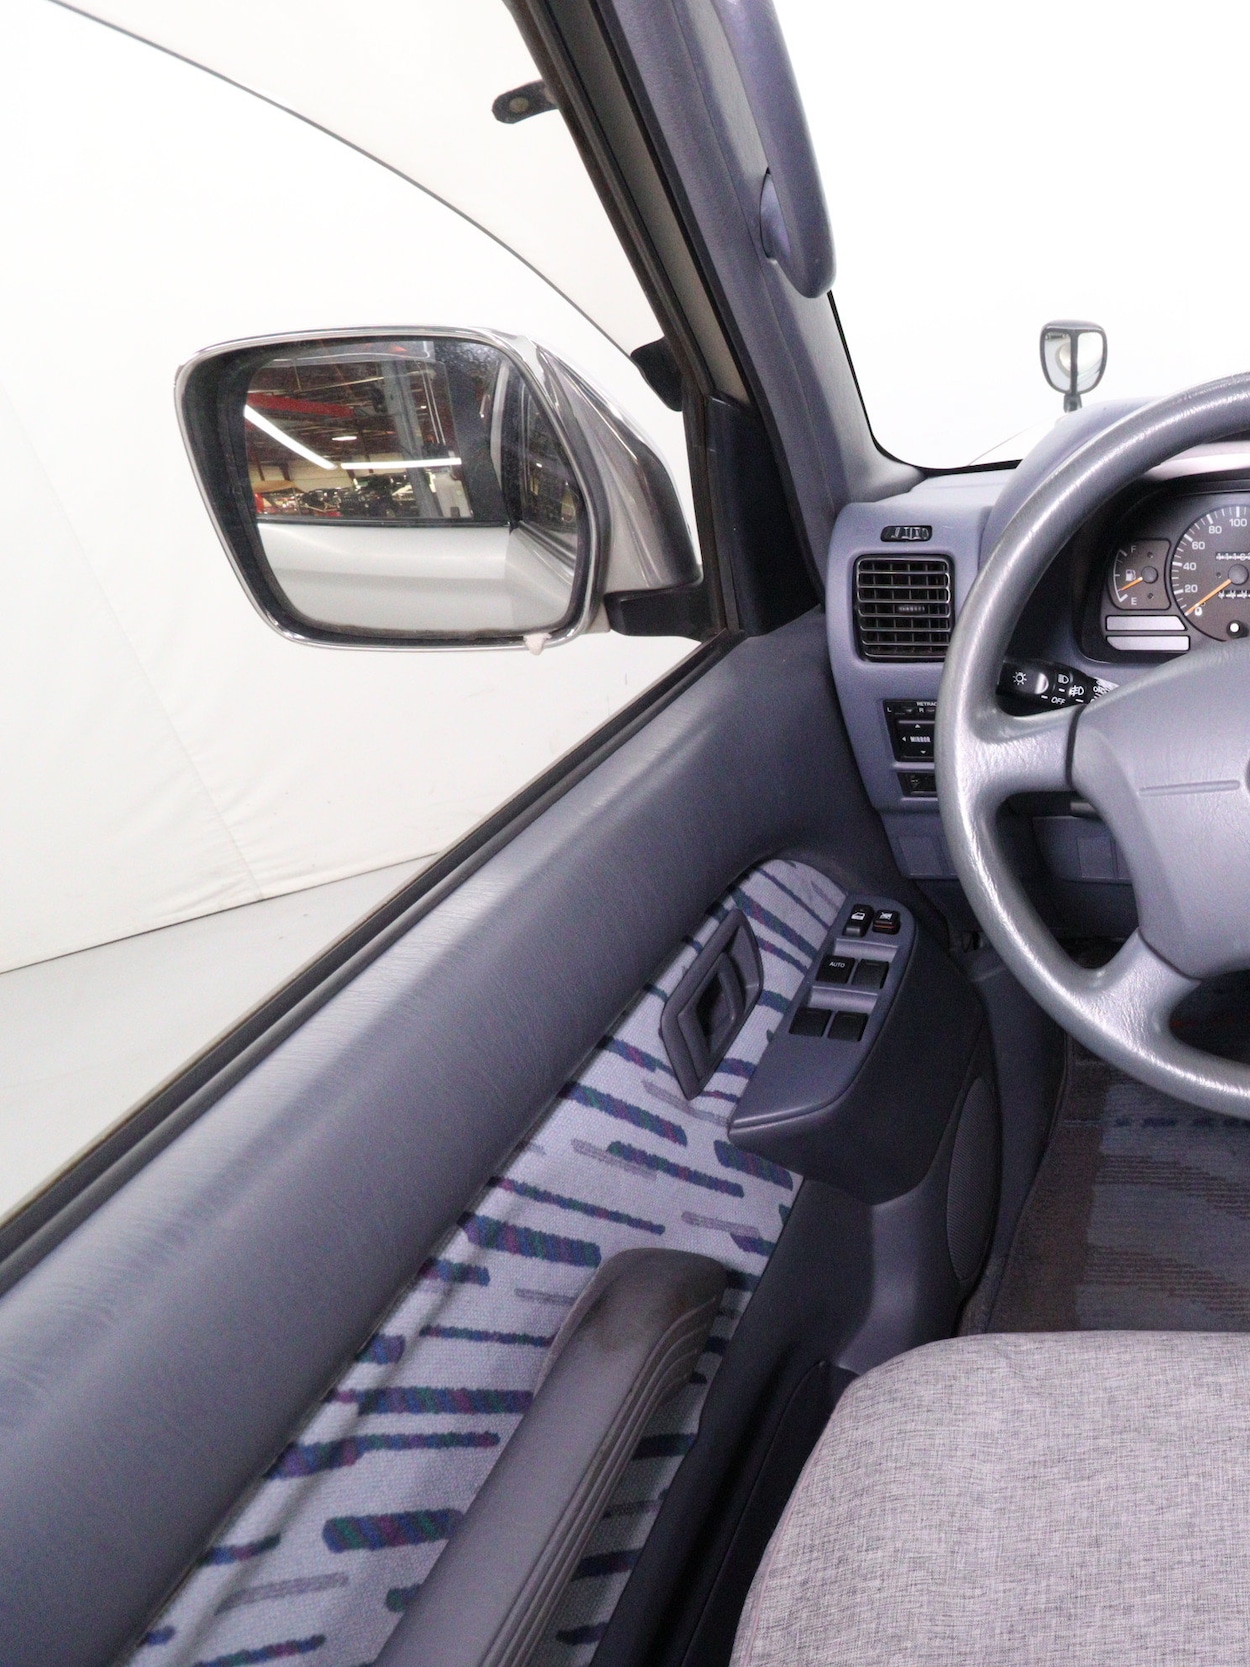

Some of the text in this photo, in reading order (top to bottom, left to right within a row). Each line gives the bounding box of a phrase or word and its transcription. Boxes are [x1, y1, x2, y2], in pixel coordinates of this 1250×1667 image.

[1229, 518, 1248, 528] 100
[1208, 525, 1222, 535] 80
[1130, 545, 1136, 553] F
[1192, 541, 1206, 550] 60
[1183, 562, 1197, 571] 40
[1184, 584, 1198, 593] 20
[1130, 597, 1137, 605] E
[1051, 696, 1066, 705] OFF
